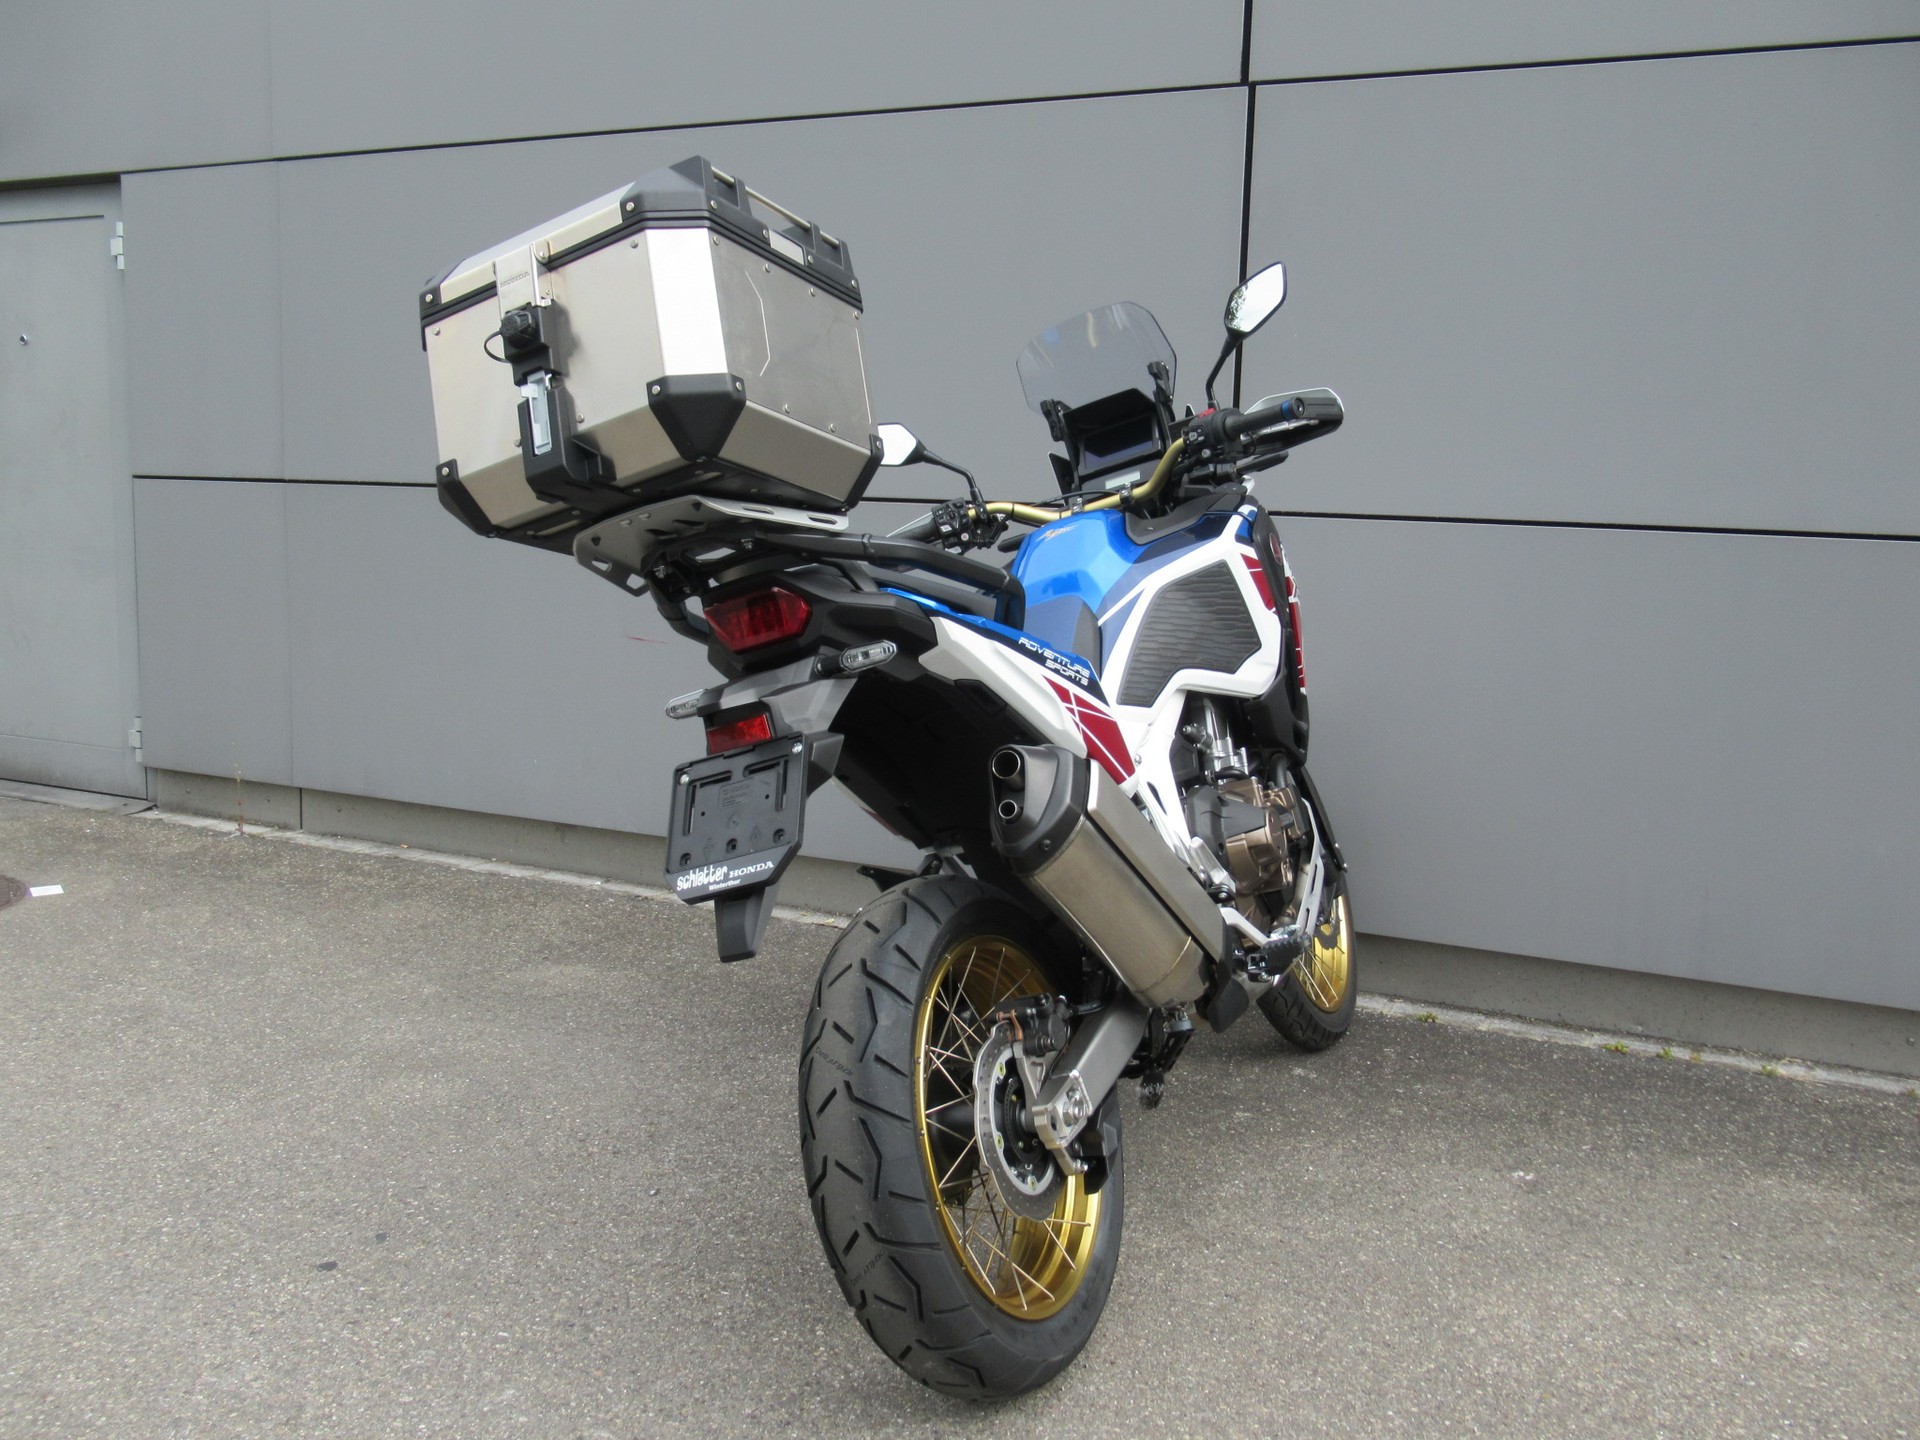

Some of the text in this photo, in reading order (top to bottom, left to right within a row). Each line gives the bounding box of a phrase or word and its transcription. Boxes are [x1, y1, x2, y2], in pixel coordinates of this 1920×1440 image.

[1018, 636, 1091, 678] ADVENTURE
[1044, 658, 1089, 686] SPORTS
[728, 860, 775, 878] HONDA
